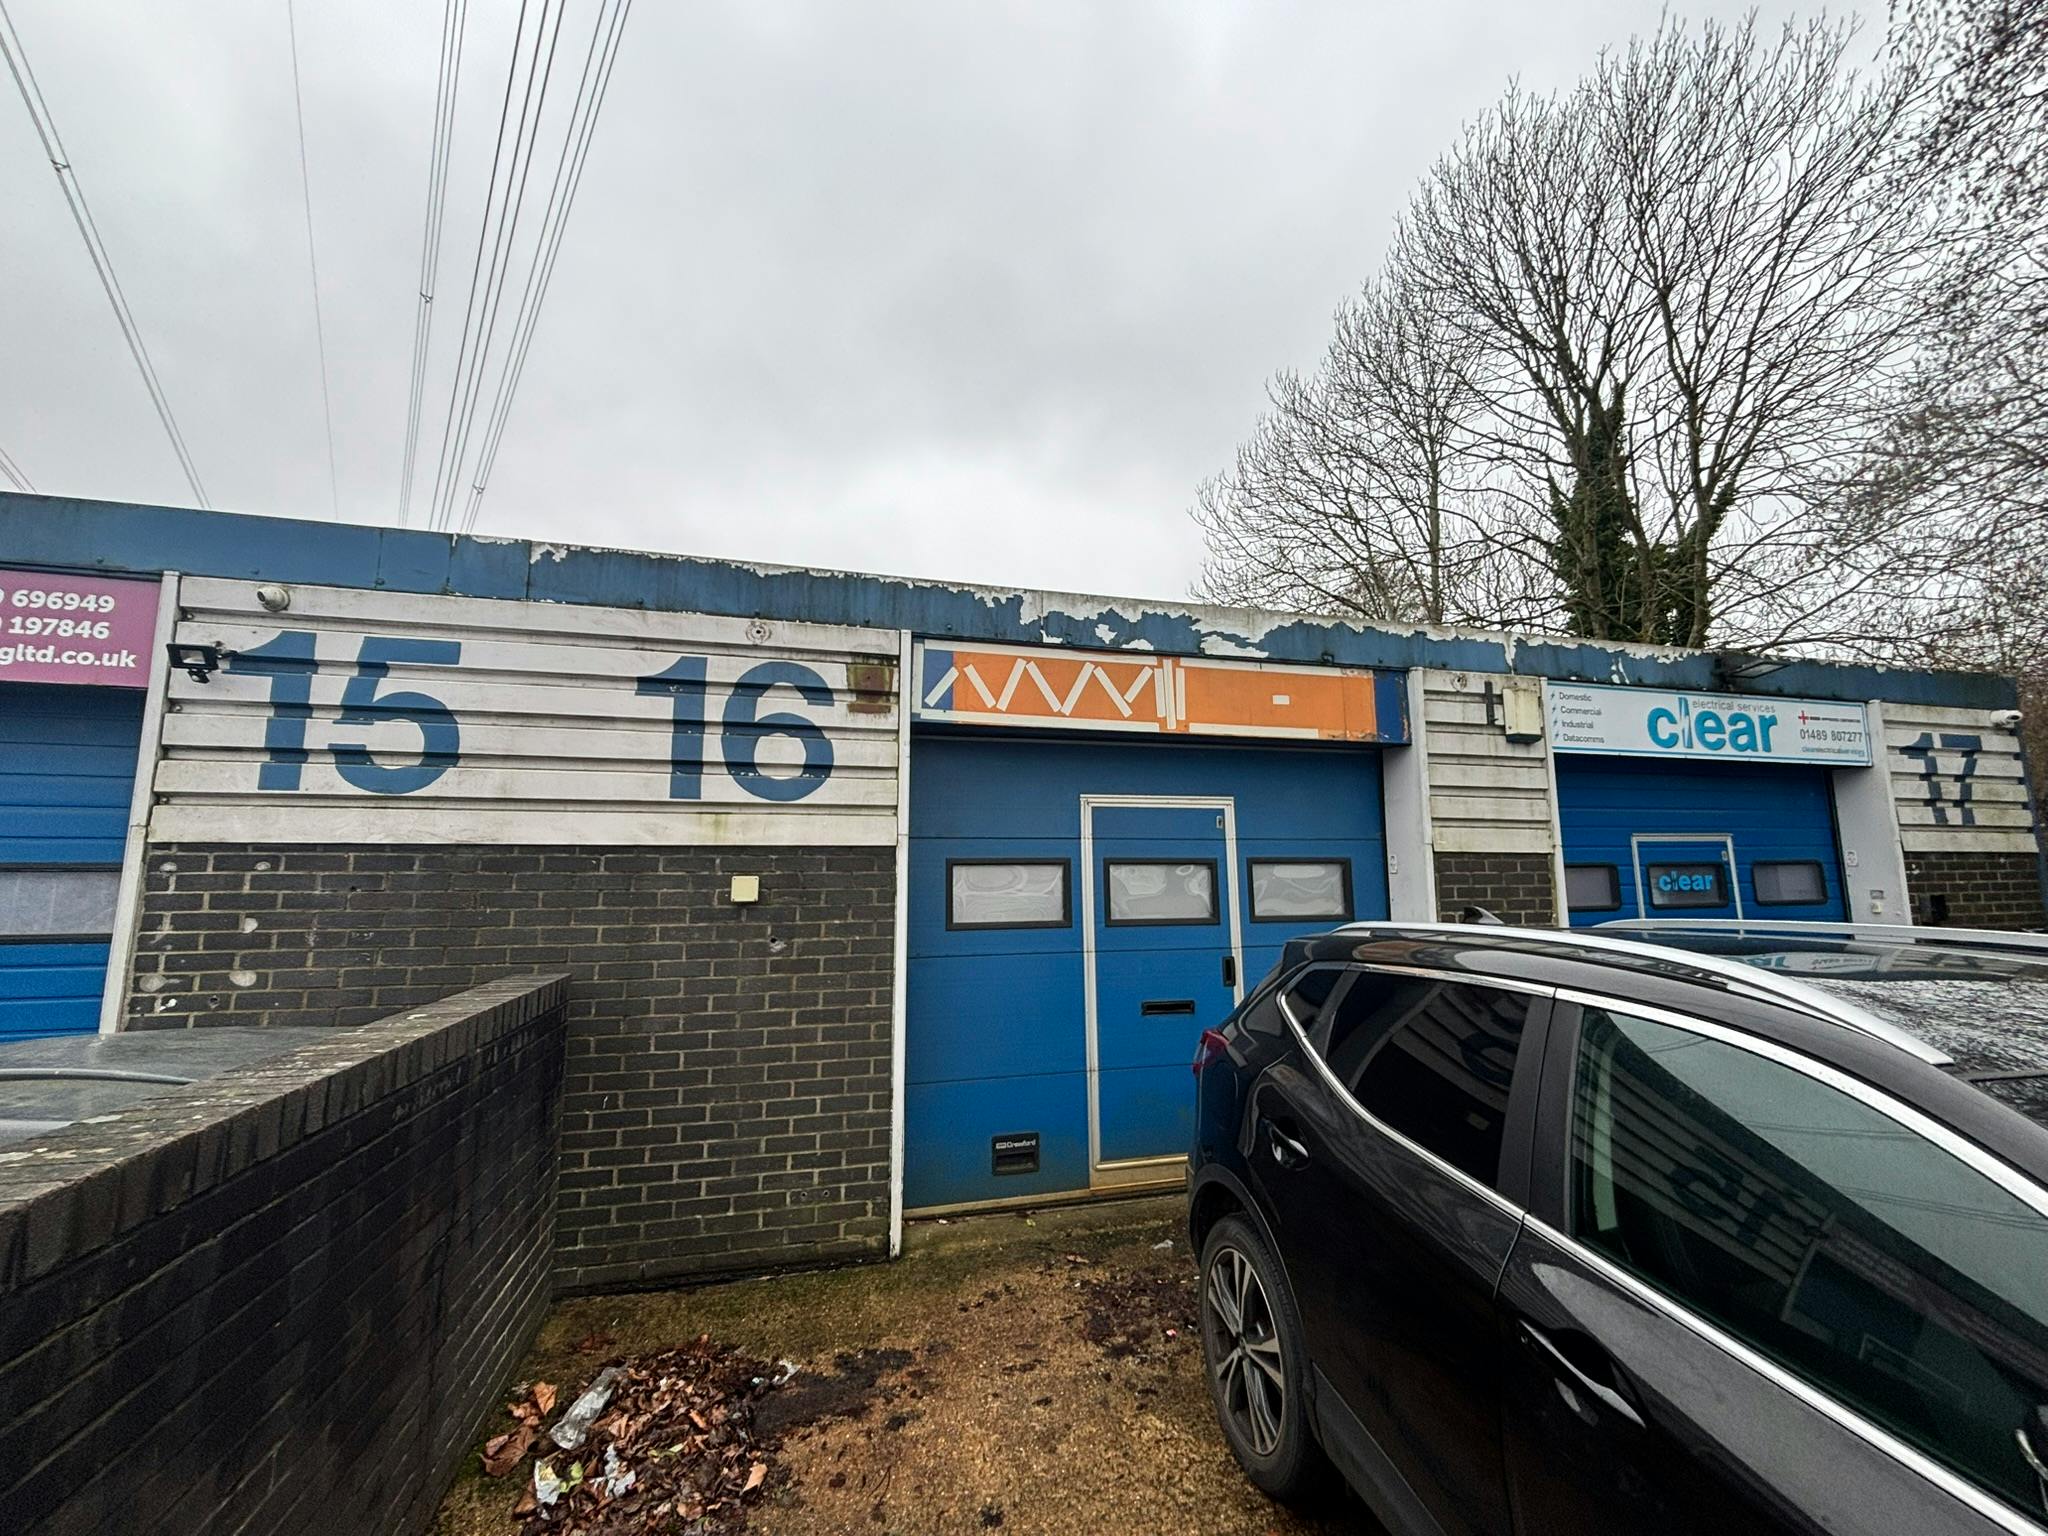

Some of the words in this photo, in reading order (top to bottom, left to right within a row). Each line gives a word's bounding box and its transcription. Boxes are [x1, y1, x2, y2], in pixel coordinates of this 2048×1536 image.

[12, 589, 116, 613] 696949
[8, 616, 110, 639] 197846
[1559, 692, 1592, 702] Domestic
[1692, 698, 1735, 710] electrical
[1737, 703, 1776, 714] services
[222, 630, 462, 795] 15
[635, 656, 836, 802] 16
[1560, 705, 1602, 716] Commercial
[1562, 720, 1594, 729] Industrial
[1647, 697, 1778, 753] clear
[1563, 733, 1605, 744] Datacomms
[1800, 728, 1828, 741] 01489
[1831, 730, 1863, 743] 807277
[1899, 731, 1983, 825] 17
[1659, 870, 1713, 891] clear
